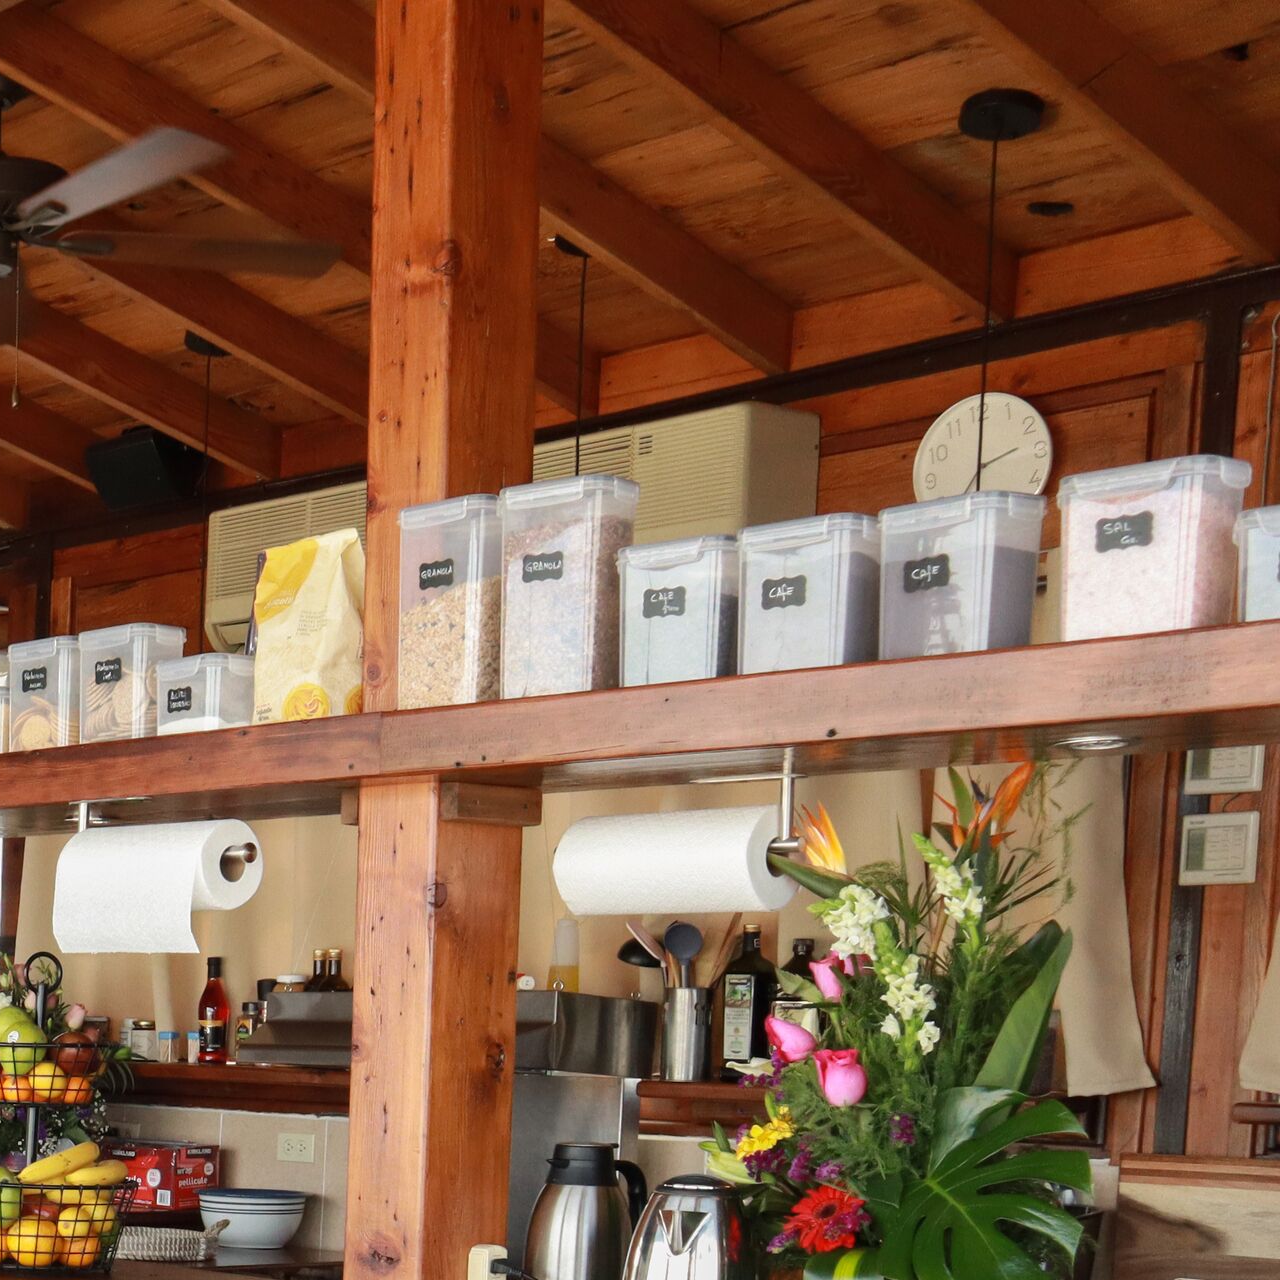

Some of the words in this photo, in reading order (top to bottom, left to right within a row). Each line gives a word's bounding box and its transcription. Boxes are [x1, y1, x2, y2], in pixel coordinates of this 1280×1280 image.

[969, 402, 989, 423] 12
[1004, 402, 1011, 420] 1
[946, 418, 962, 439] 11
[1022, 415, 1036, 435] 2
[928, 444, 949, 464] 10
[1033, 440, 1048, 459] 3
[925, 472, 937, 490] 9
[1028, 468, 1042, 487] 4
[1103, 521, 1132, 534] SAL
[420, 565, 453, 579] GRANOLA
[525, 560, 562, 577] GRANOLA
